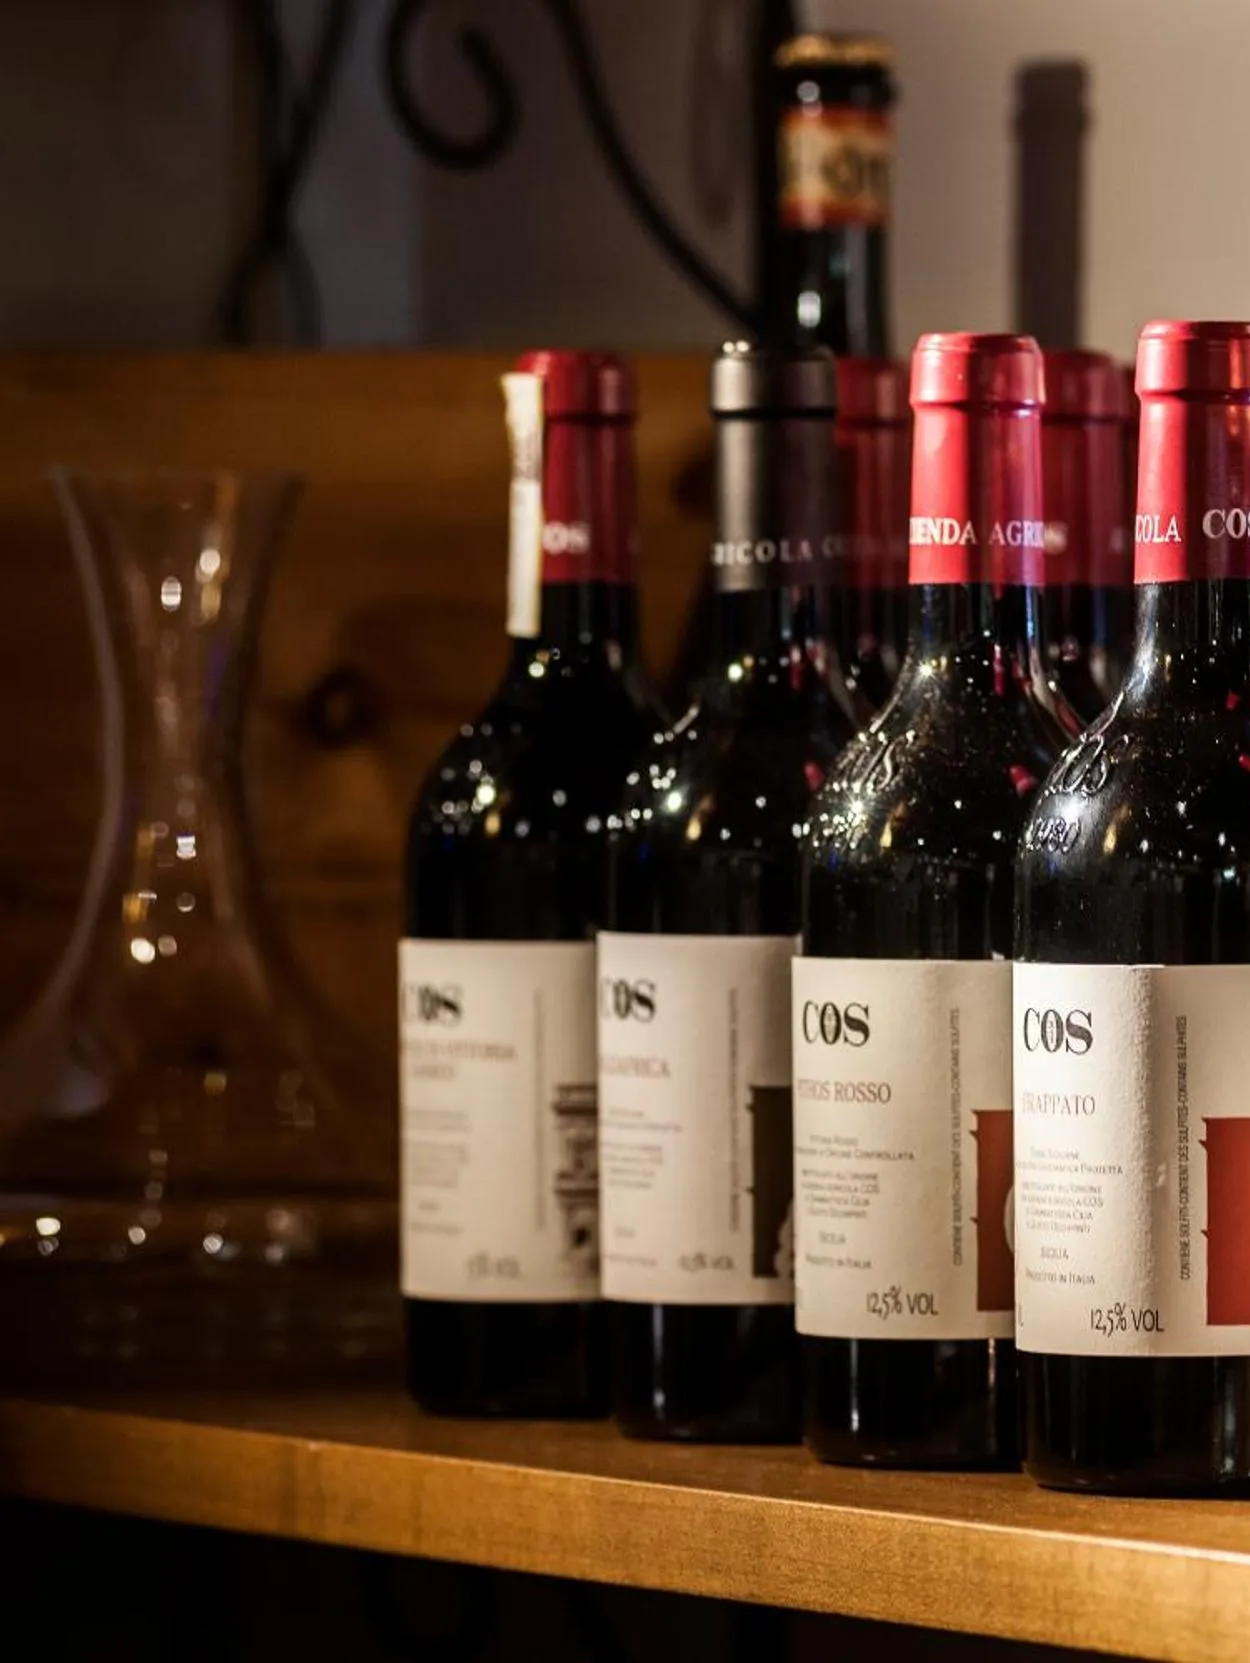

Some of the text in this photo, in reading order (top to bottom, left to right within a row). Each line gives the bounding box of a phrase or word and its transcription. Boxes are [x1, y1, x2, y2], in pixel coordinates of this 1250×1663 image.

[803, 1000, 870, 1048] COS
[1024, 1008, 1093, 1055] COS
[835, 1081, 891, 1104] ROSSO
[866, 1283, 939, 1320] 12,5% VOL
[1091, 1302, 1165, 1338] 12,5% VOL
